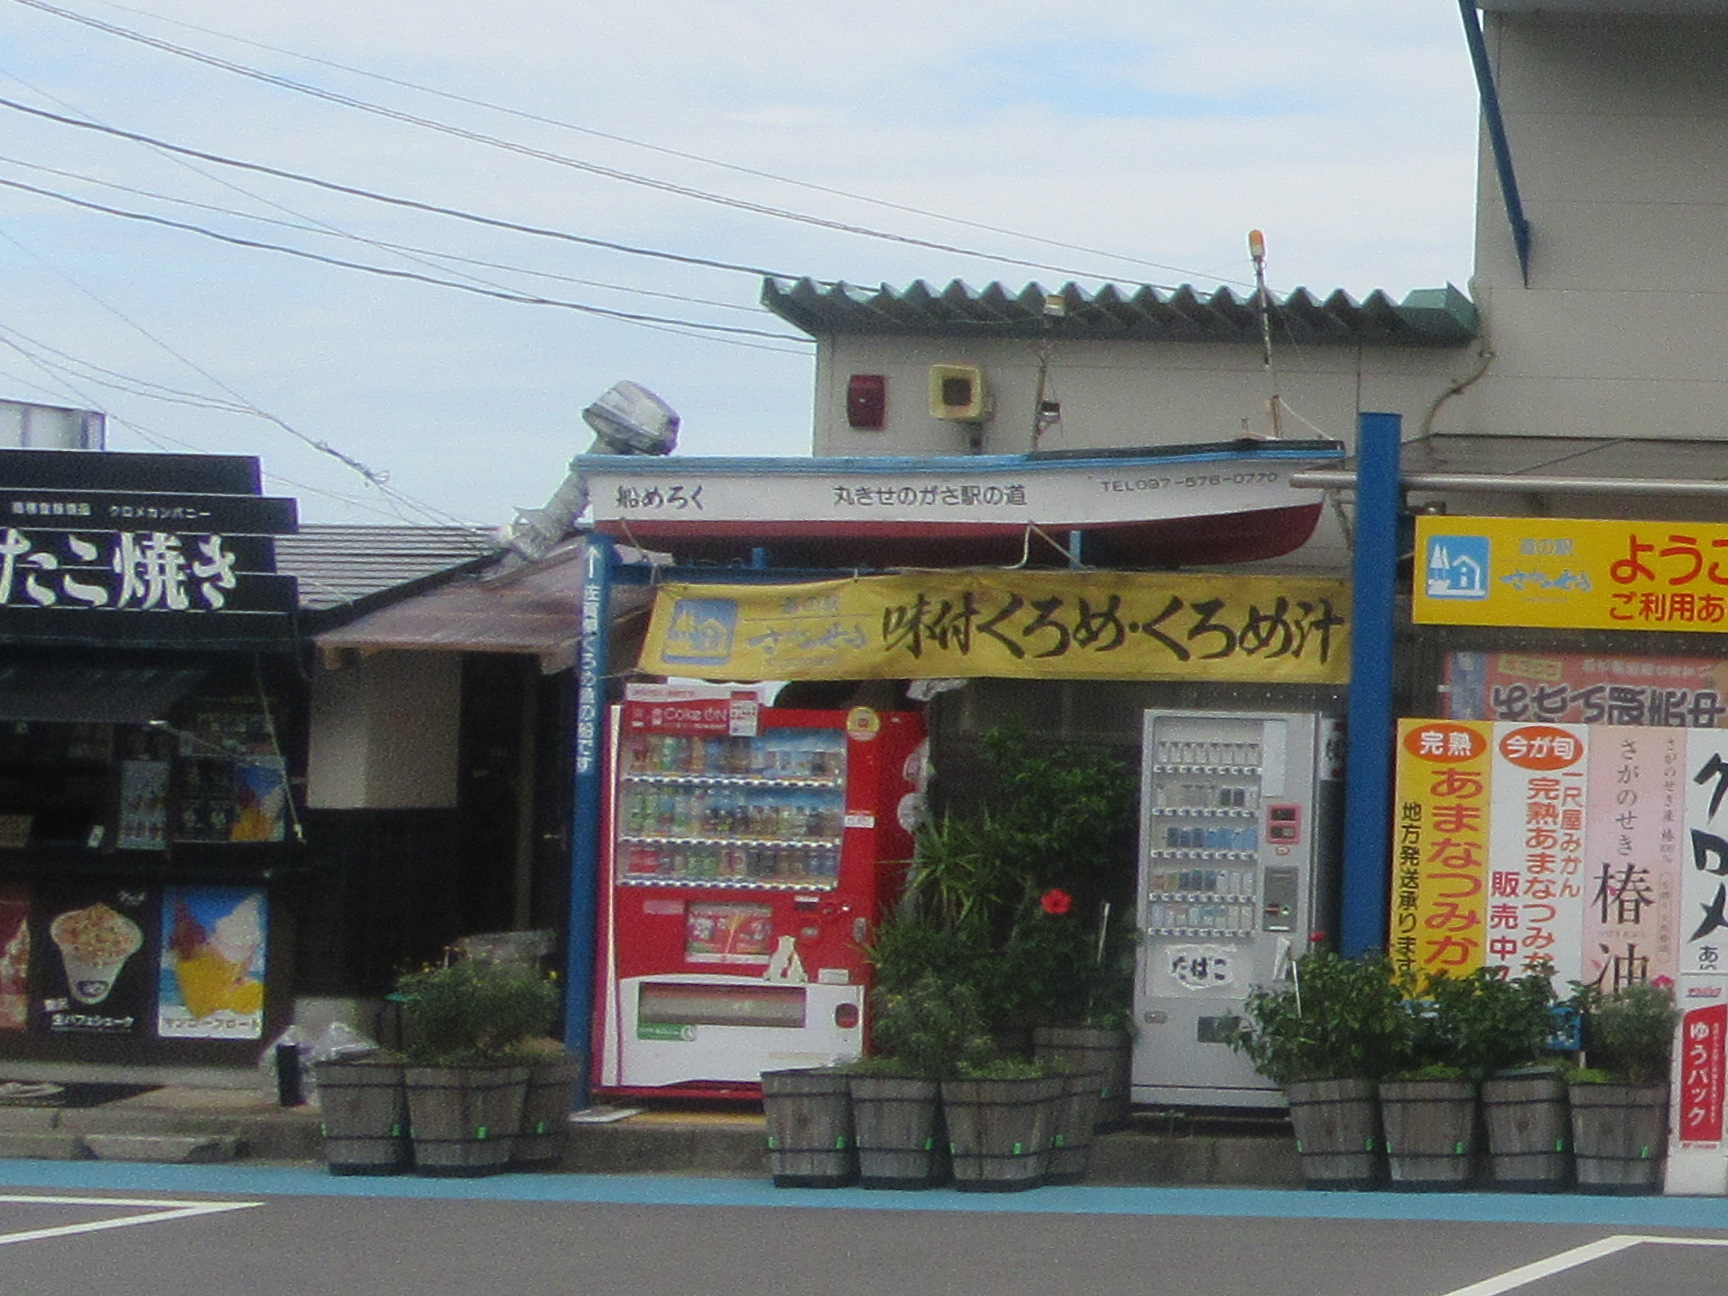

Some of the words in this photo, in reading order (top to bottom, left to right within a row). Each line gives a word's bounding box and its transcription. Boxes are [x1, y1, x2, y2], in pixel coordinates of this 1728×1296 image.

[882, 592, 1345, 664] 味付くろめ・くろめ汁
[1419, 730, 1472, 756] 完熟
[1506, 735, 1575, 760] 今が旬
[1559, 770, 1584, 899] 一尺屋みかん
[1614, 738, 1641, 856] さがのせき
[1423, 766, 1484, 980] あまなつみか
[1685, 1021, 1711, 1127] ゆうパック
